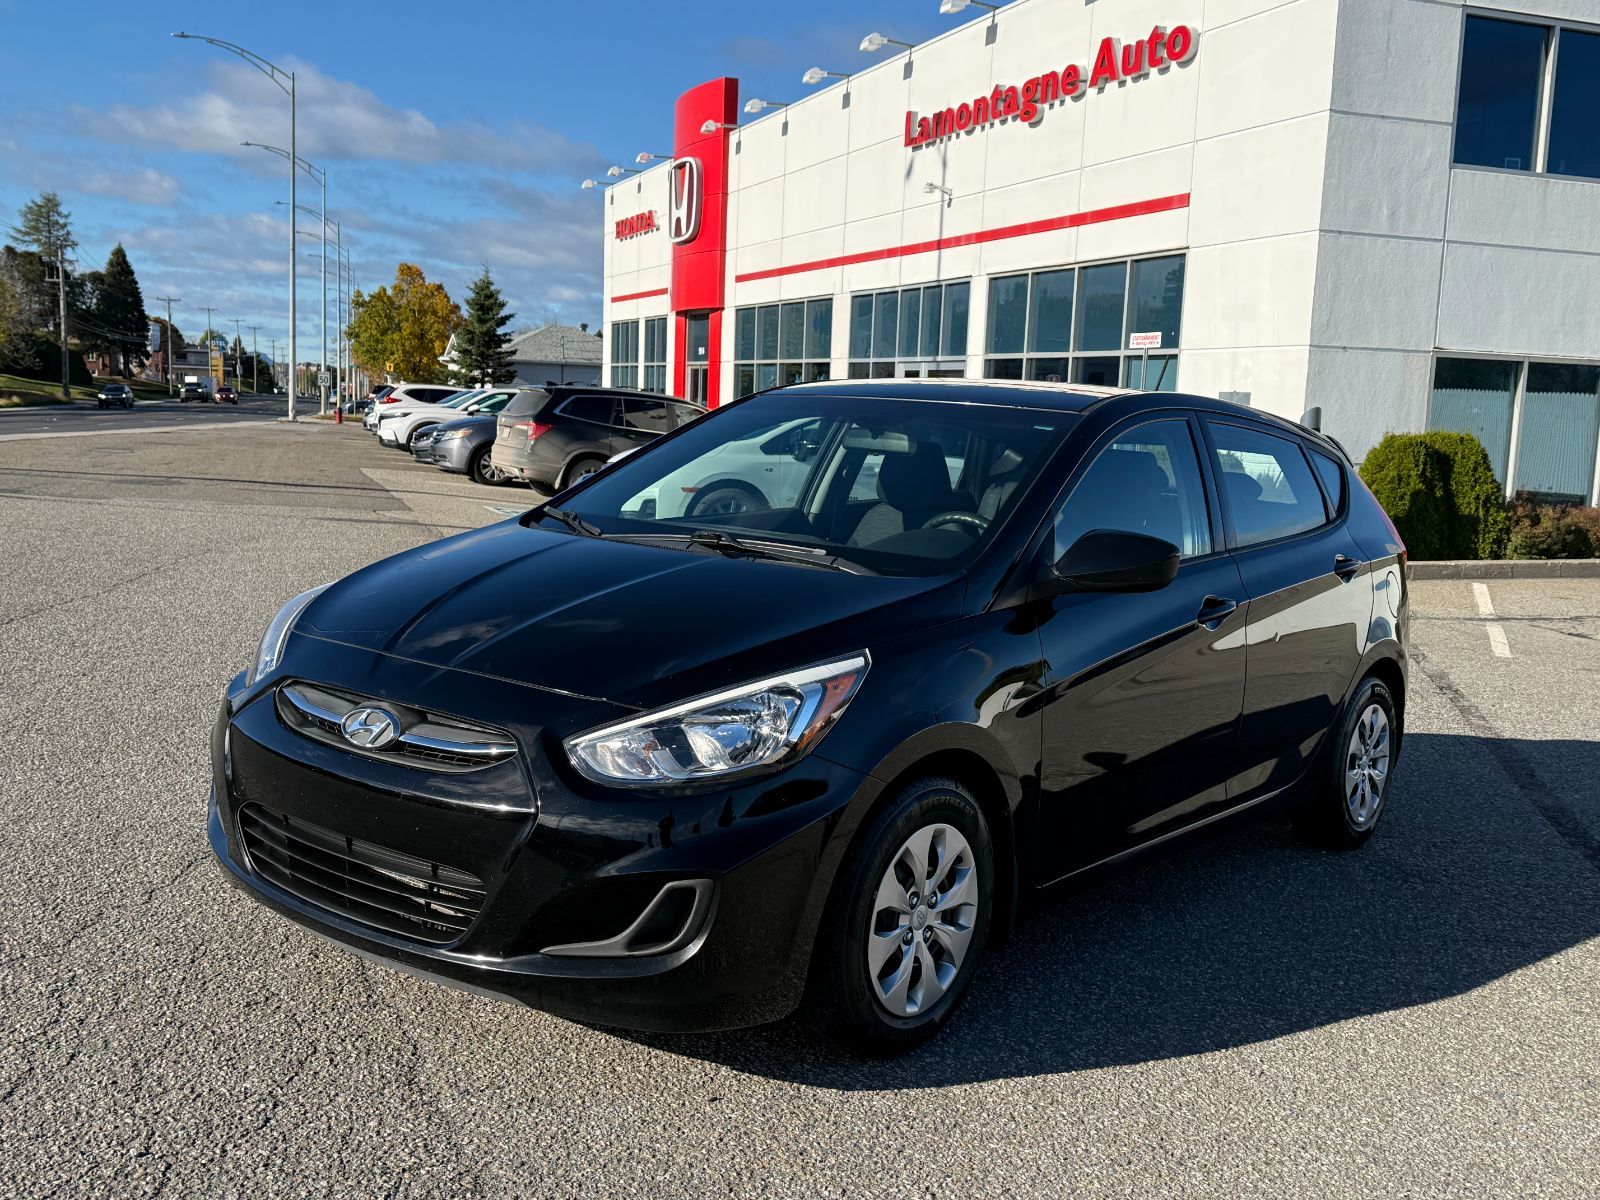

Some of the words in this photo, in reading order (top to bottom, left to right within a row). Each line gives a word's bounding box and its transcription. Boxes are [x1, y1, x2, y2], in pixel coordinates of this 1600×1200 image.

[904, 64, 1080, 147] Lamontagne
[1088, 25, 1193, 88] Auto
[615, 210, 656, 239] HONDA
[319, 375, 329, 384] 50
